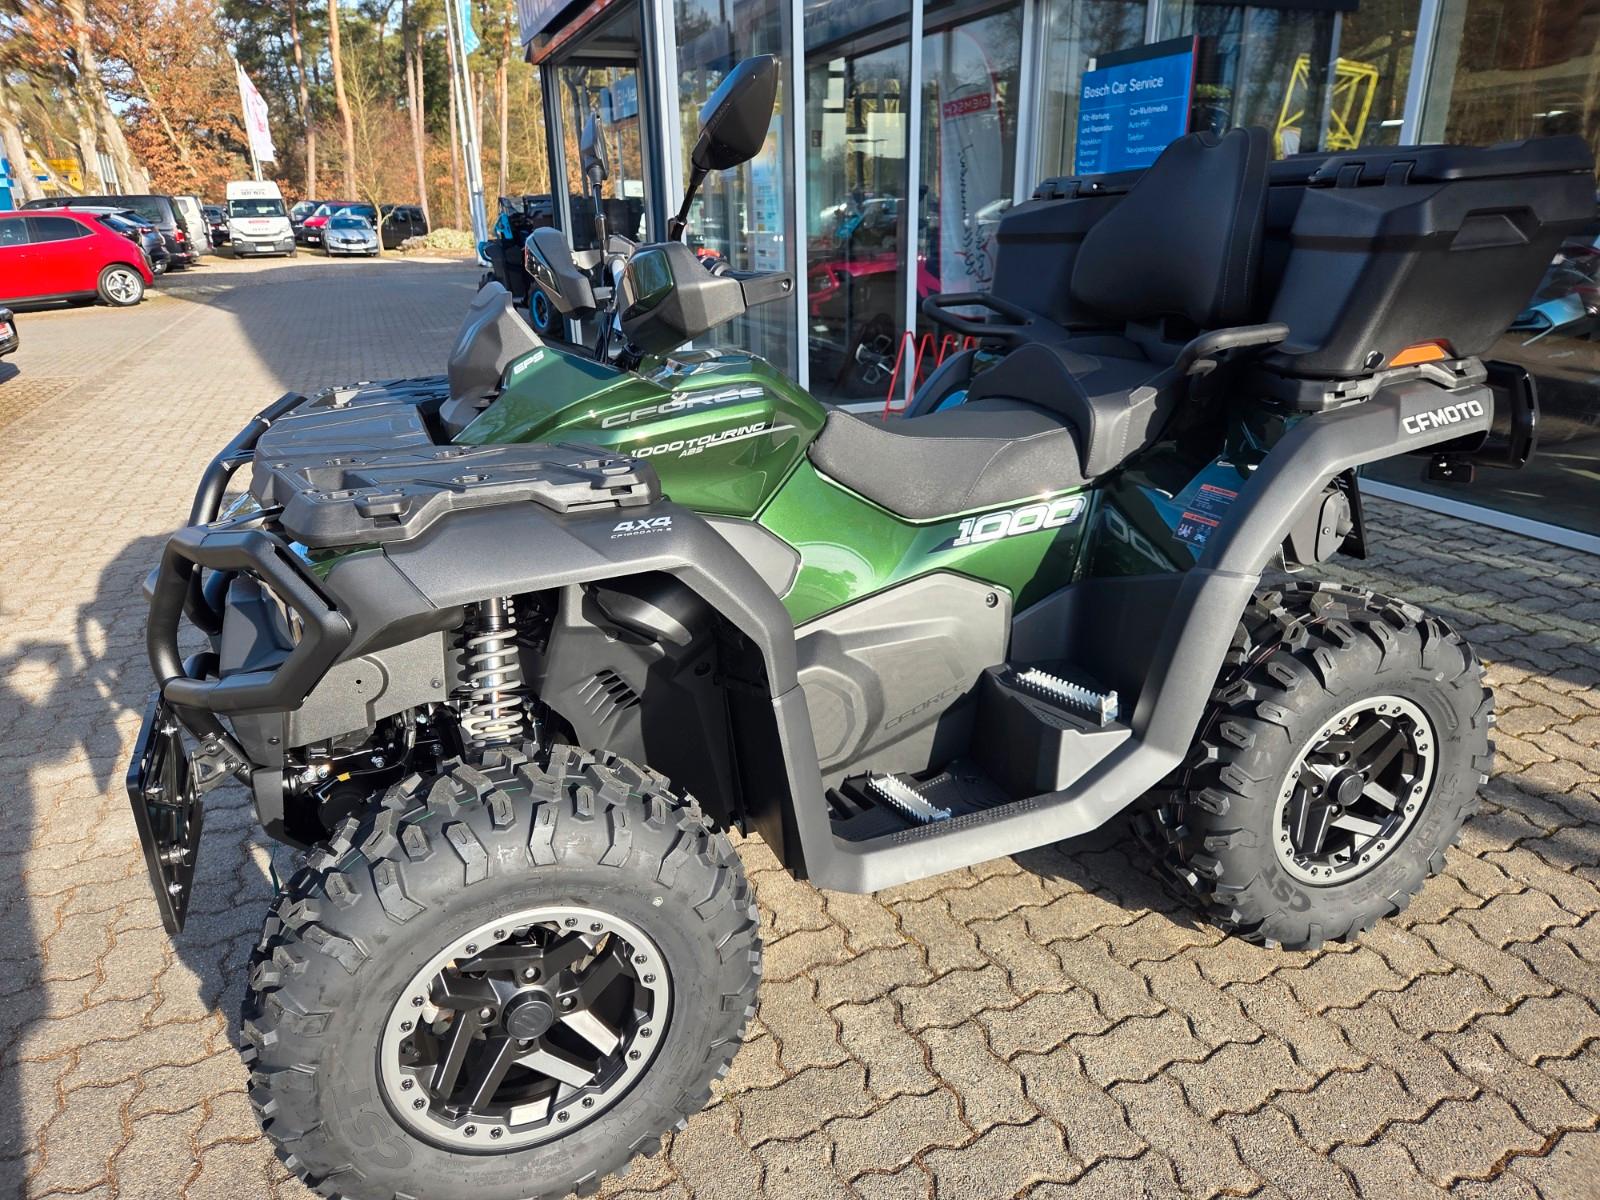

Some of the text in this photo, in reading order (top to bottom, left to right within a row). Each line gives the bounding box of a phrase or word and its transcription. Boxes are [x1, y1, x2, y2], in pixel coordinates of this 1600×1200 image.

[1083, 75, 1164, 99] Bosch Car Service
[513, 350, 545, 375] EPS
[601, 386, 765, 429] CFORCE
[1402, 400, 1484, 435] CFMOTO
[631, 421, 767, 459] 1000 TOURING
[678, 446, 705, 459] ABS
[952, 495, 1087, 547] 1000
[1260, 862, 1312, 913] CST
[331, 1083, 414, 1170] CST
